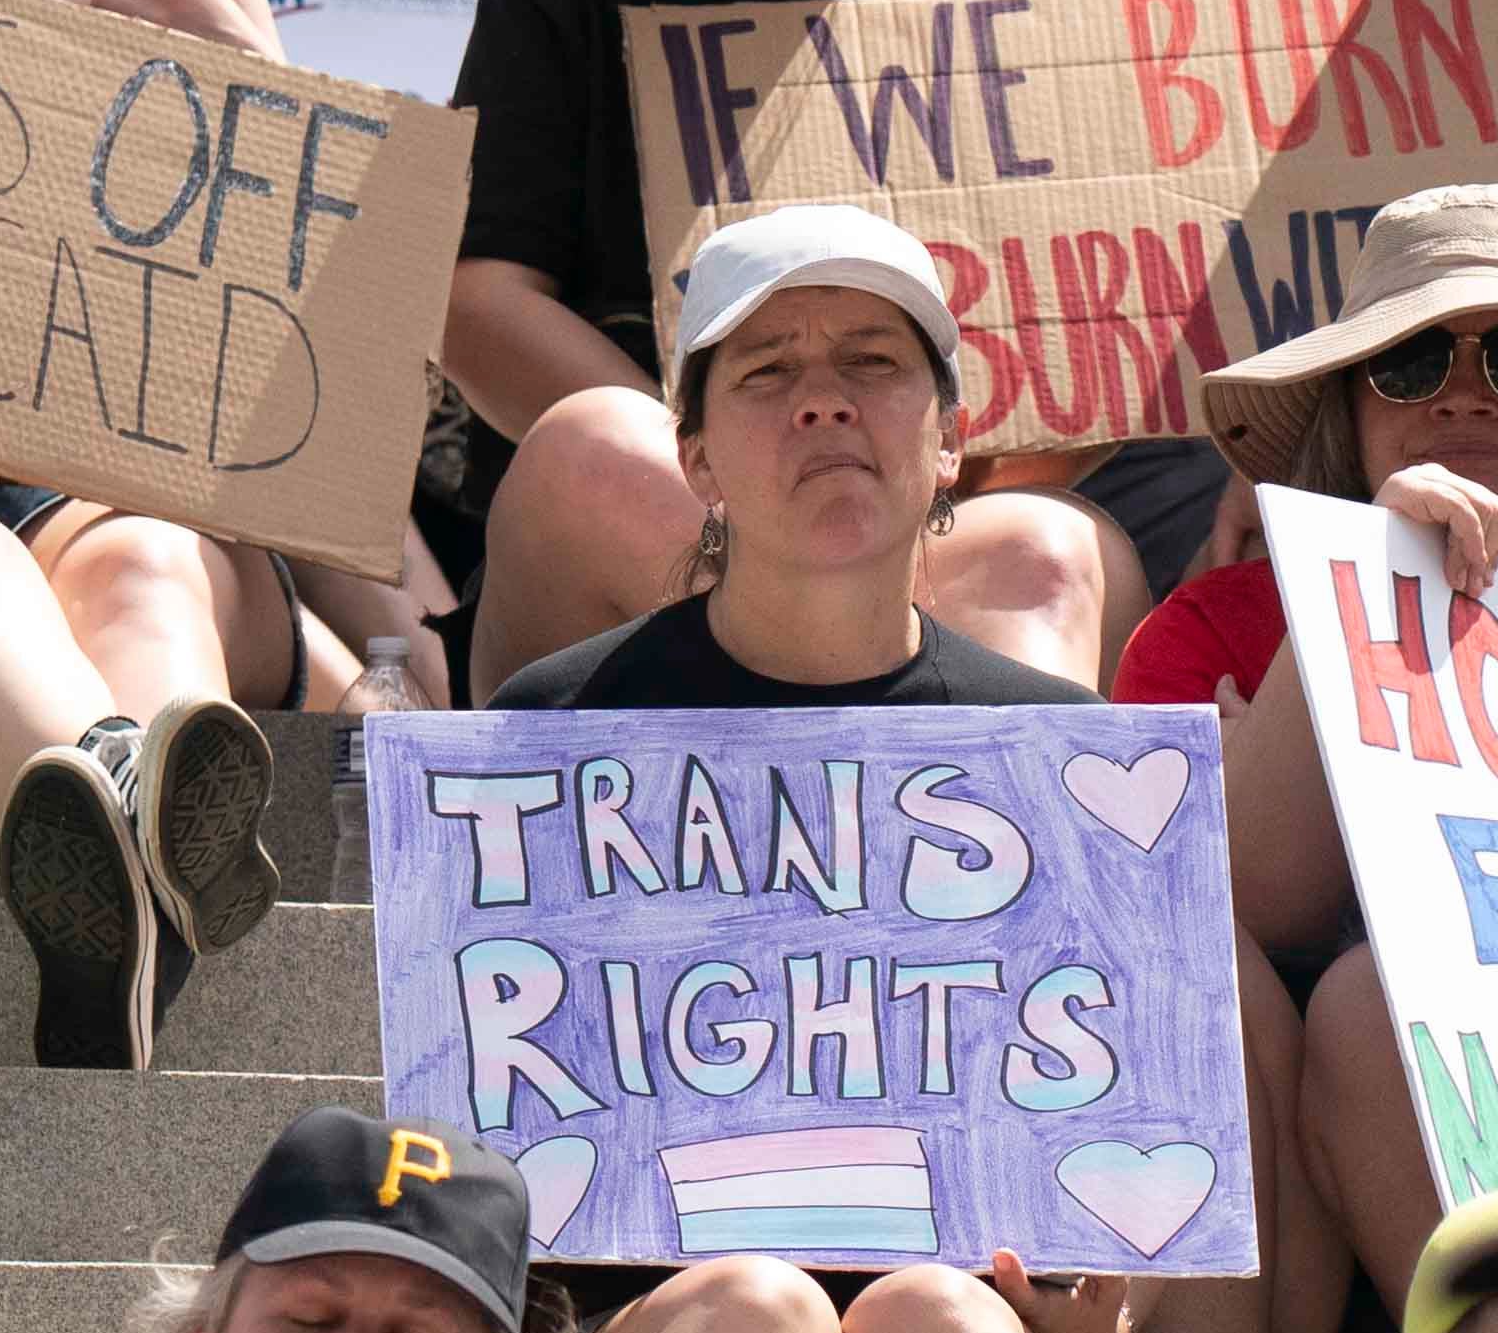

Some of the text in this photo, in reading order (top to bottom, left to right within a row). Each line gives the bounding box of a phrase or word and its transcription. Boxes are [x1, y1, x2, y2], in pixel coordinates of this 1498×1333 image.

[90, 58, 389, 292] OFF
[659, 18, 758, 208] IF
[927, 219, 1230, 440] BURN
[426, 753, 1035, 922] TRANS
[454, 936, 1121, 1132] RIGHTS
[377, 1129, 451, 1209] P
